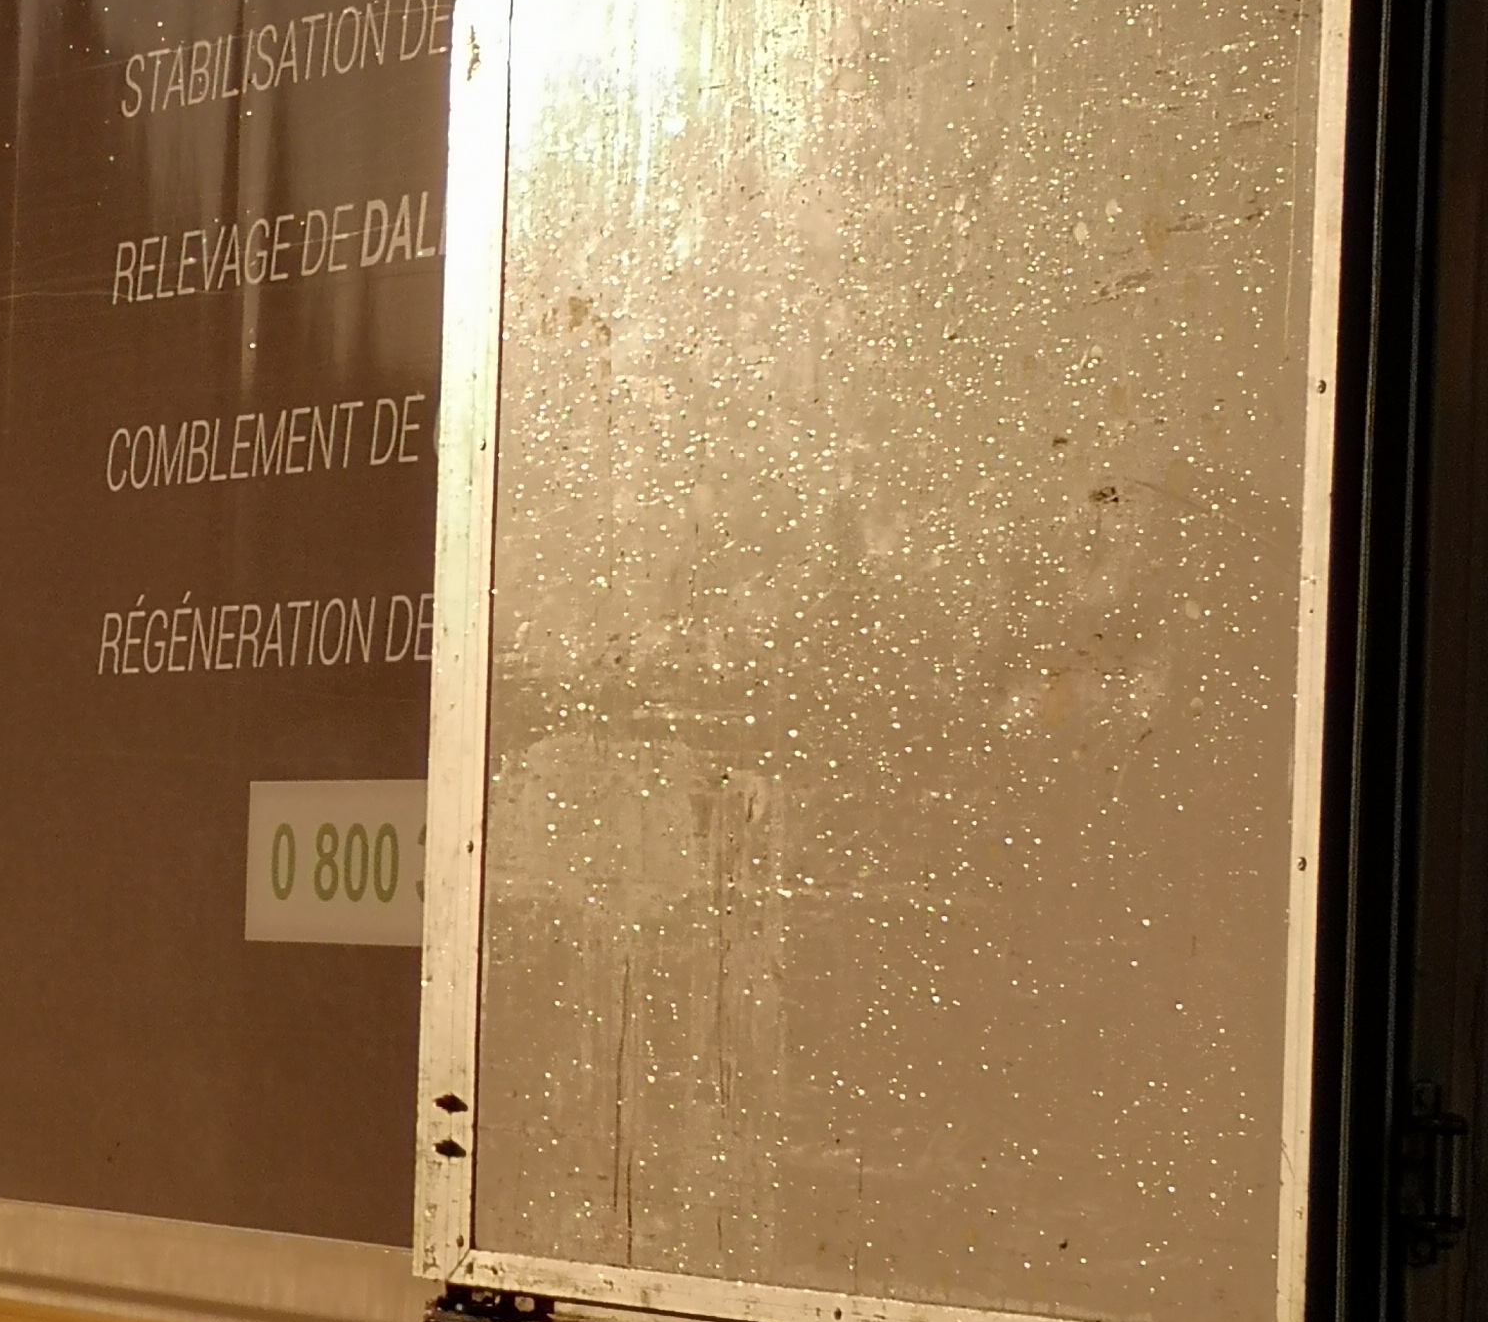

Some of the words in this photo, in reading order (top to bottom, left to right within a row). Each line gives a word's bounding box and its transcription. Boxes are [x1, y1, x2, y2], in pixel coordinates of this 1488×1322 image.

[121, 0, 391, 118] STABILISATION
[112, 215, 295, 306] RELEVAGE
[300, 204, 354, 277] DE
[106, 400, 365, 492] COMBLEMENT
[370, 394, 426, 466] DE
[97, 591, 376, 676] RÉGÉNERATION
[385, 593, 435, 663] DE
[271, 823, 296, 901] 0
[313, 822, 400, 903] 800
